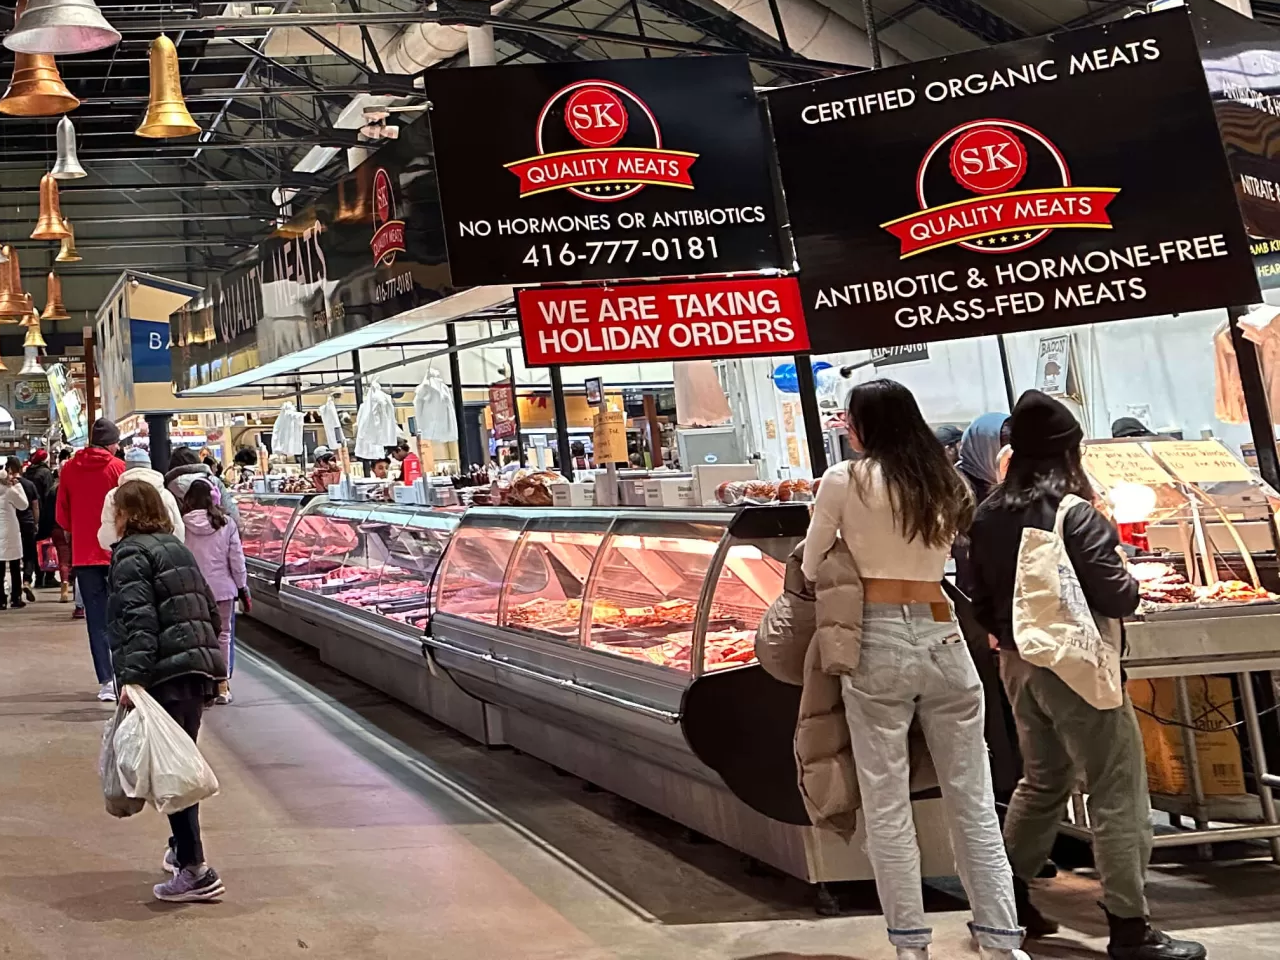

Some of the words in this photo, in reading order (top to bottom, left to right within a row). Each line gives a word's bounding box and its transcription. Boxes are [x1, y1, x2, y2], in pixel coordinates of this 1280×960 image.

[801, 88, 916, 125] CERTIFIED
[924, 60, 1057, 102] ORGANIC
[1069, 39, 1160, 75] MEATS
[571, 102, 620, 130] SK
[527, 157, 609, 184] QUALITY
[617, 158, 680, 177] MEATS
[960, 142, 1018, 176] SK
[1240, 174, 1275, 203] NITRATE
[459, 220, 491, 237] NO
[498, 214, 611, 235] HORMONES
[617, 212, 646, 229] OR
[652, 206, 766, 228] ANTIBIOTICS
[909, 203, 1005, 242] QUALITY
[1014, 197, 1092, 220] MEATS
[522, 236, 719, 268] 416-777-0181
[1249, 241, 1269, 255] AMB
[220, 259, 264, 344] QUALITY
[272, 220, 327, 311] MEATS
[814, 270, 958, 310] ANTIBIOTIC
[967, 266, 988, 289] &
[995, 234, 1229, 285] HORMONE-FREE
[537, 300, 589, 324] WE
[598, 296, 659, 323] ARE
[668, 290, 780, 318] TAKING
[895, 291, 1045, 328] GRASS-FED
[1054, 277, 1147, 310] MEATS
[538, 324, 662, 354] HOLIDAY
[668, 317, 795, 348] ORDERS
[1040, 339, 1065, 357] BACON
